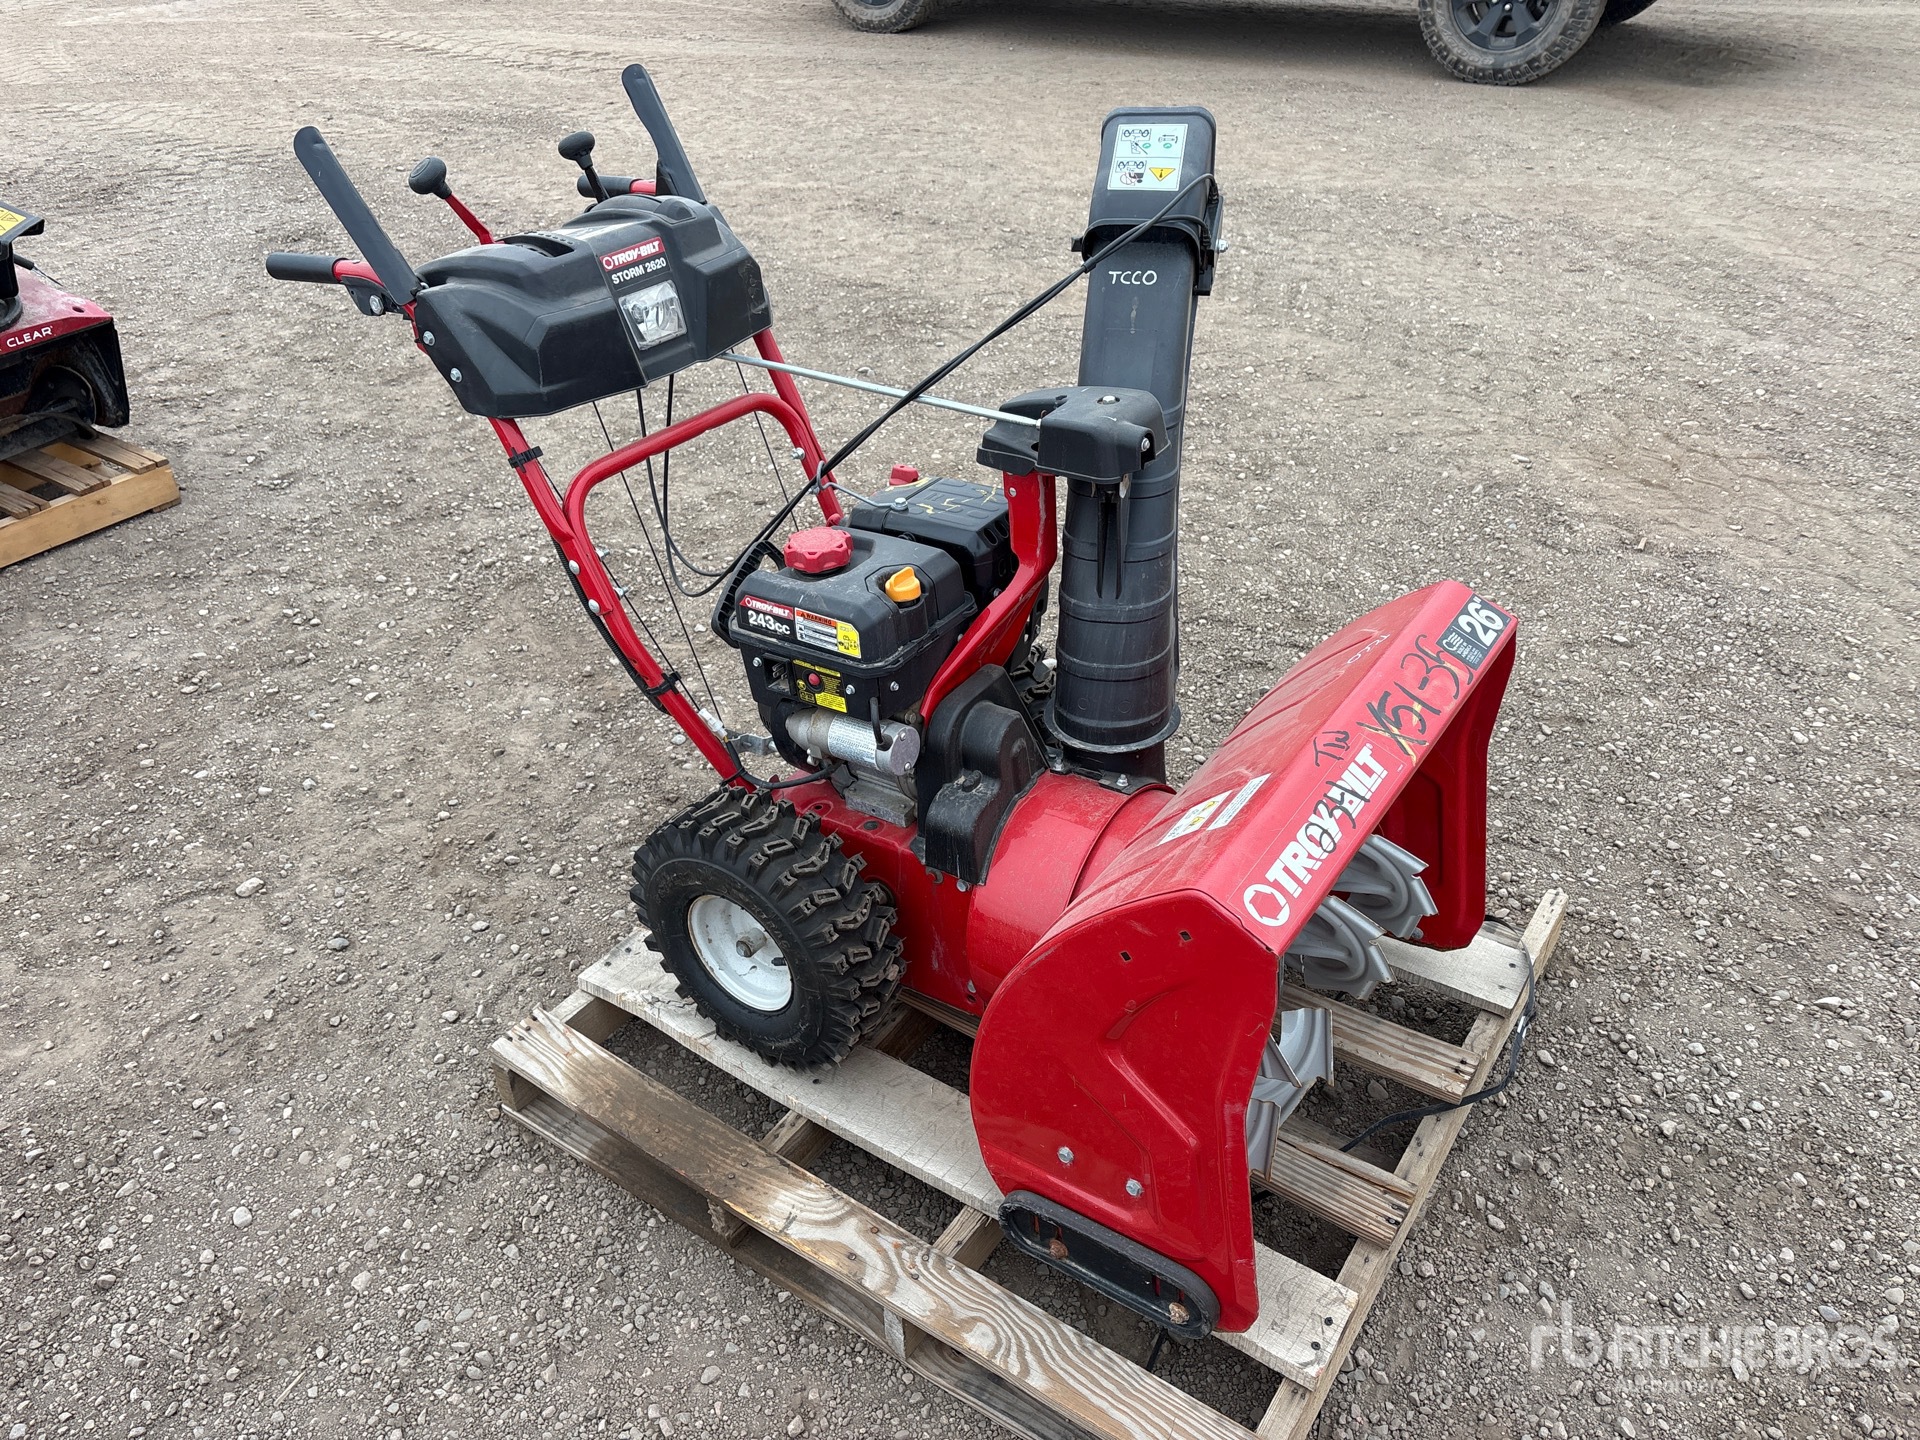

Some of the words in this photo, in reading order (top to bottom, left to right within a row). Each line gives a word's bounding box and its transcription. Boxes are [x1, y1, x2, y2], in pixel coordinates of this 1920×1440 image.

[611, 241, 660, 266] TROY-BILT
[611, 265, 645, 284] STORM
[645, 257, 667, 272] 2620
[1108, 270, 1158, 286] TCCO
[6, 327, 52, 347] CLEAR
[751, 600, 790, 617] TROY-BILT
[807, 612, 832, 626] WARNING
[747, 610, 791, 634] 243cc
[1265, 746, 1389, 898] TROY-BILT
